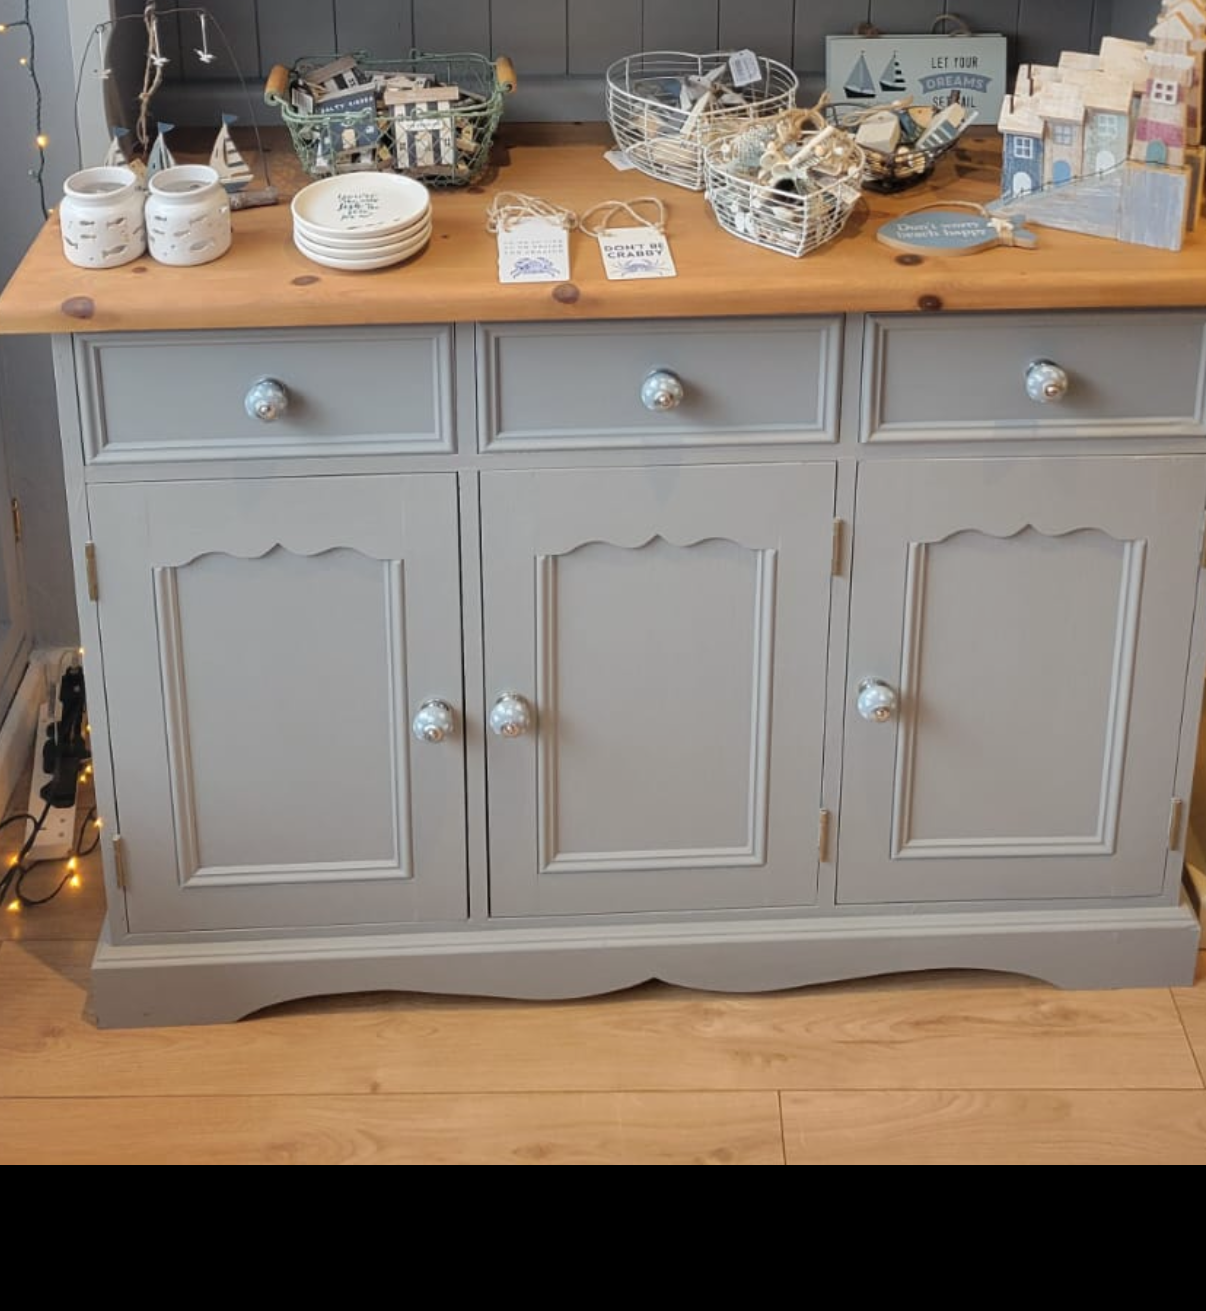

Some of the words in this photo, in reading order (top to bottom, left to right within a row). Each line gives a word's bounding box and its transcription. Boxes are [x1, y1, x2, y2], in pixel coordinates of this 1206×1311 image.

[931, 57, 949, 69] LET
[954, 56, 979, 69] YOUR
[926, 76, 984, 89] DREAMS
[897, 223, 936, 231] Don't
[604, 243, 645, 251] DON'T
[607, 250, 662, 258] CRABBY
